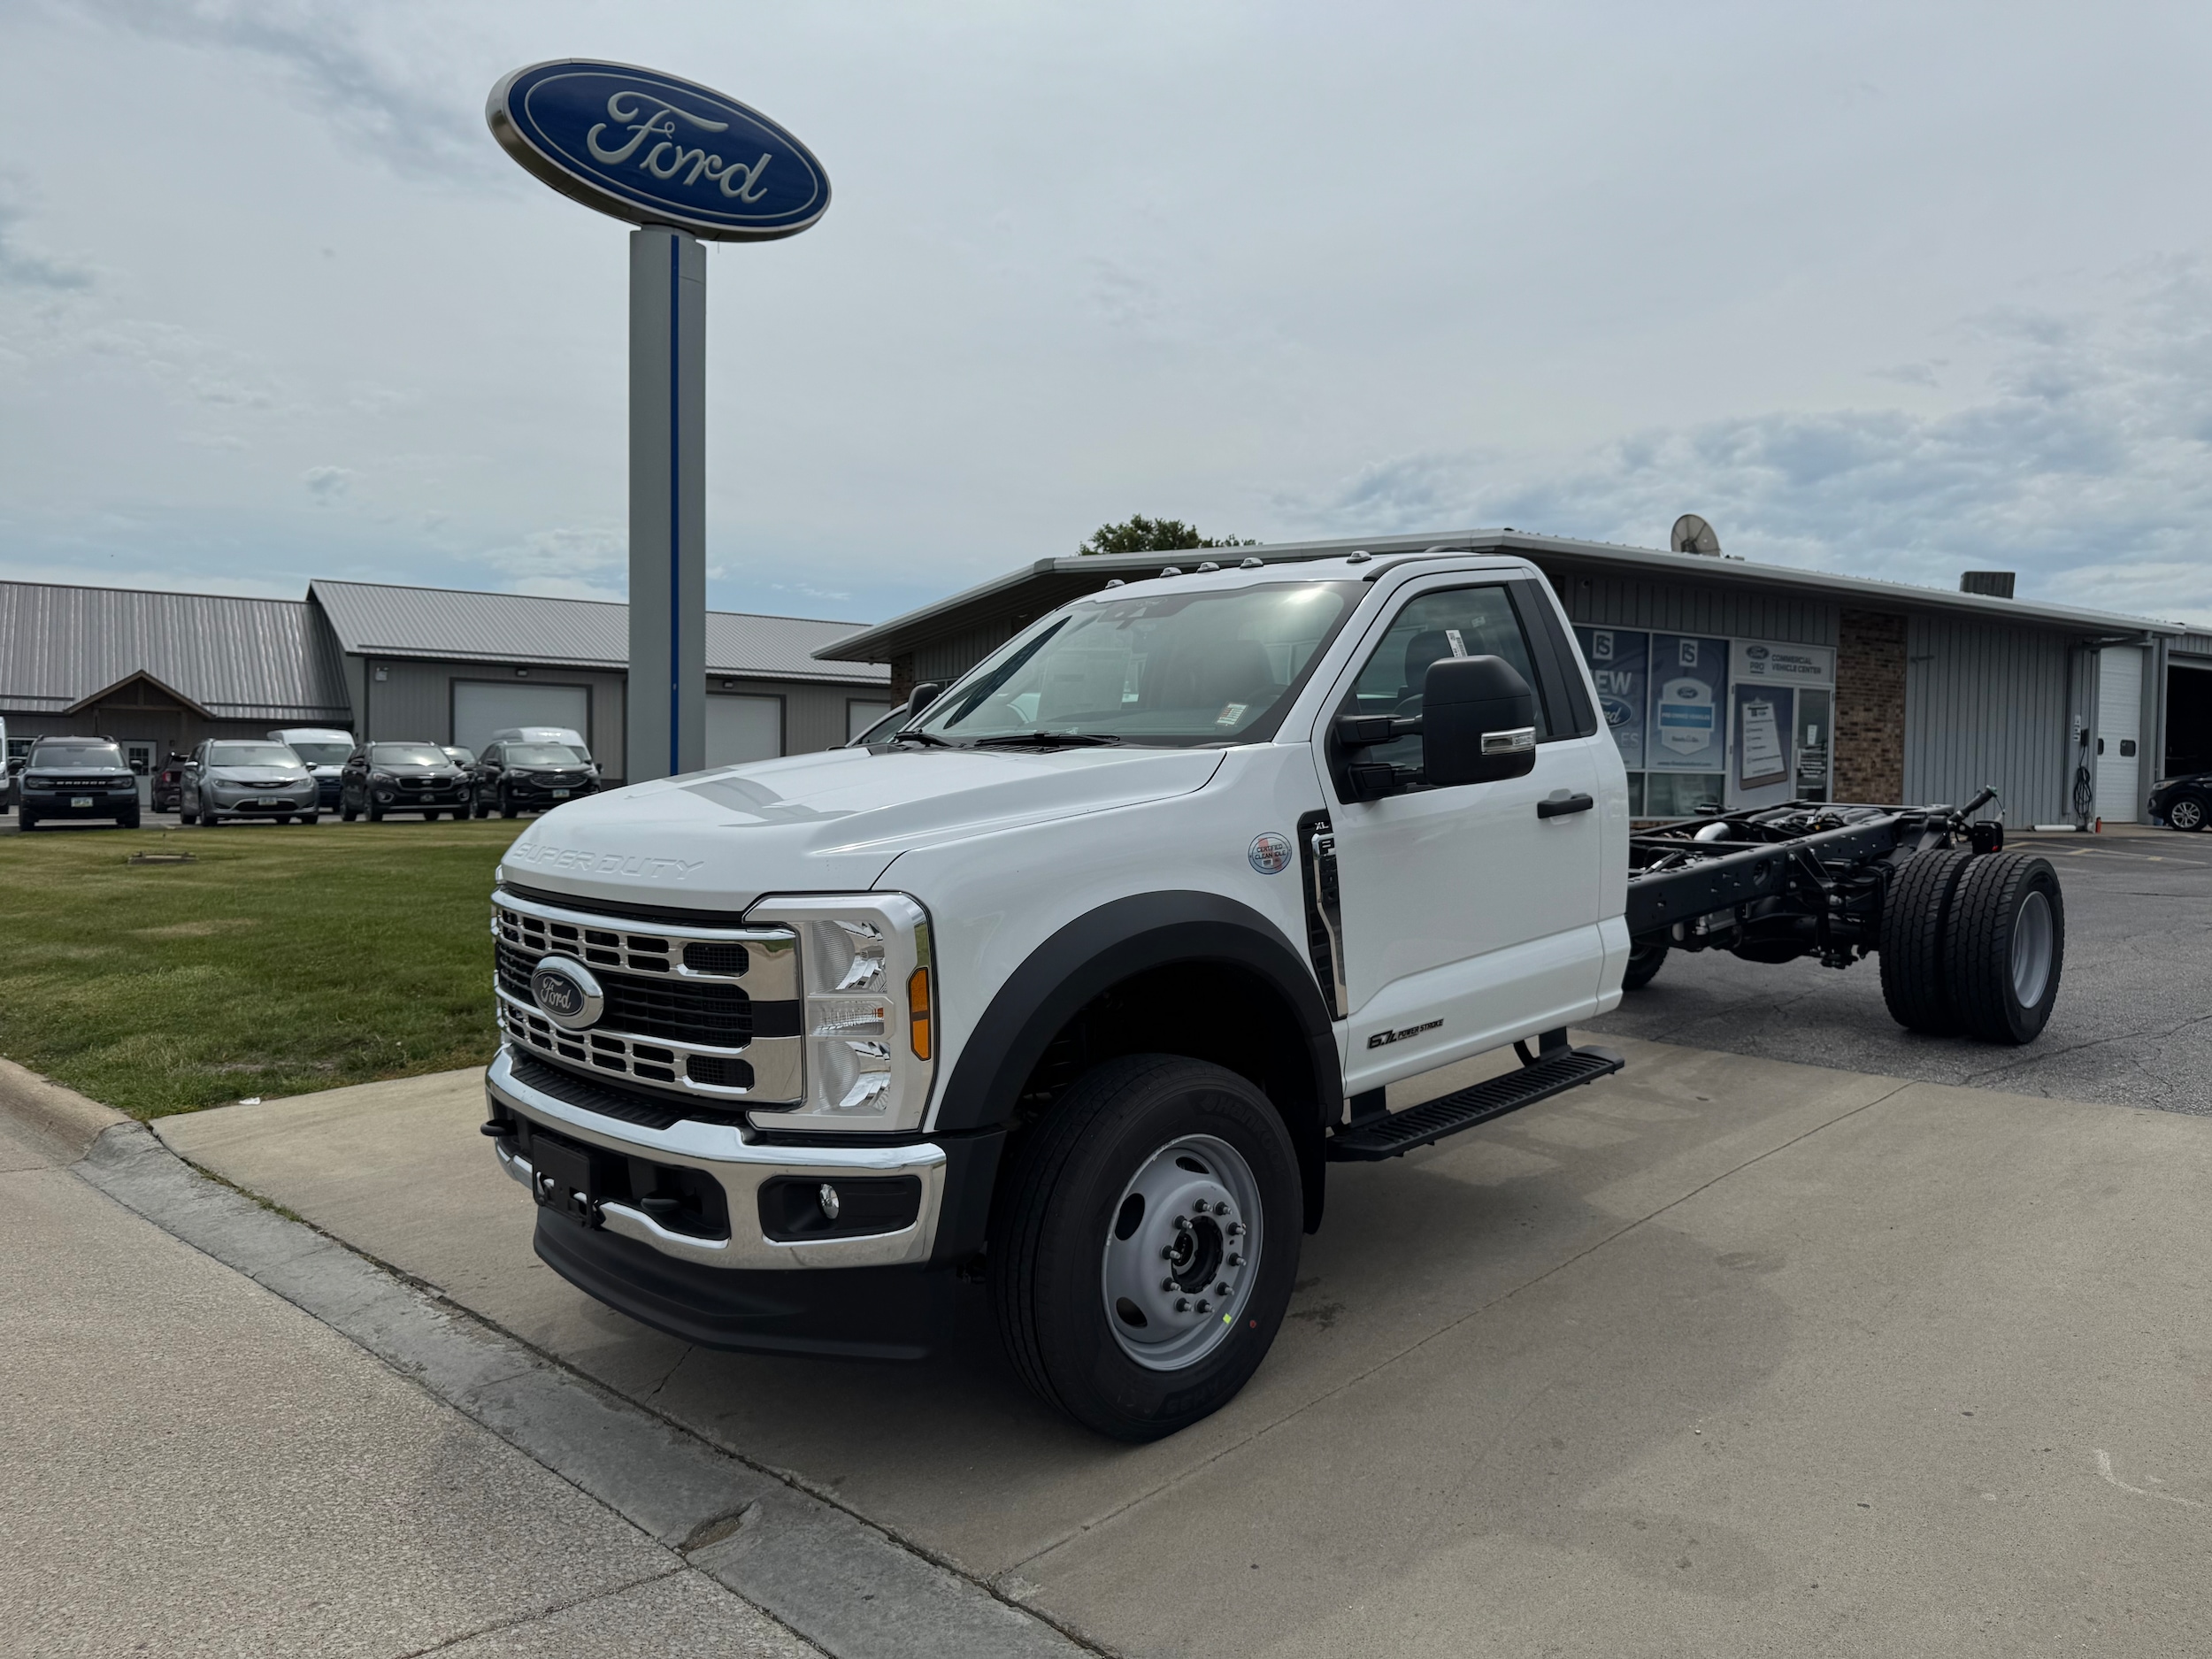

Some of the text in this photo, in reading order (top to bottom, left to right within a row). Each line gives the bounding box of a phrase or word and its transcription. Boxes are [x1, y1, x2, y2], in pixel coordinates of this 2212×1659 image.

[587, 89, 772, 204] Ford
[1750, 661, 1764, 671] PRO
[1771, 654, 1812, 665] COMMERCIAL
[1771, 663, 1822, 674] VEHICLE CENTER
[1589, 669, 1632, 695] EW
[1314, 821, 1329, 831] XL
[1256, 843, 1283, 853] CERTIFIED
[511, 841, 706, 880] SUPER DUTY
[540, 976, 572, 1009] Ford
[1398, 1025, 1419, 1037] POWER
[1419, 1018, 1445, 1032] STROKE
